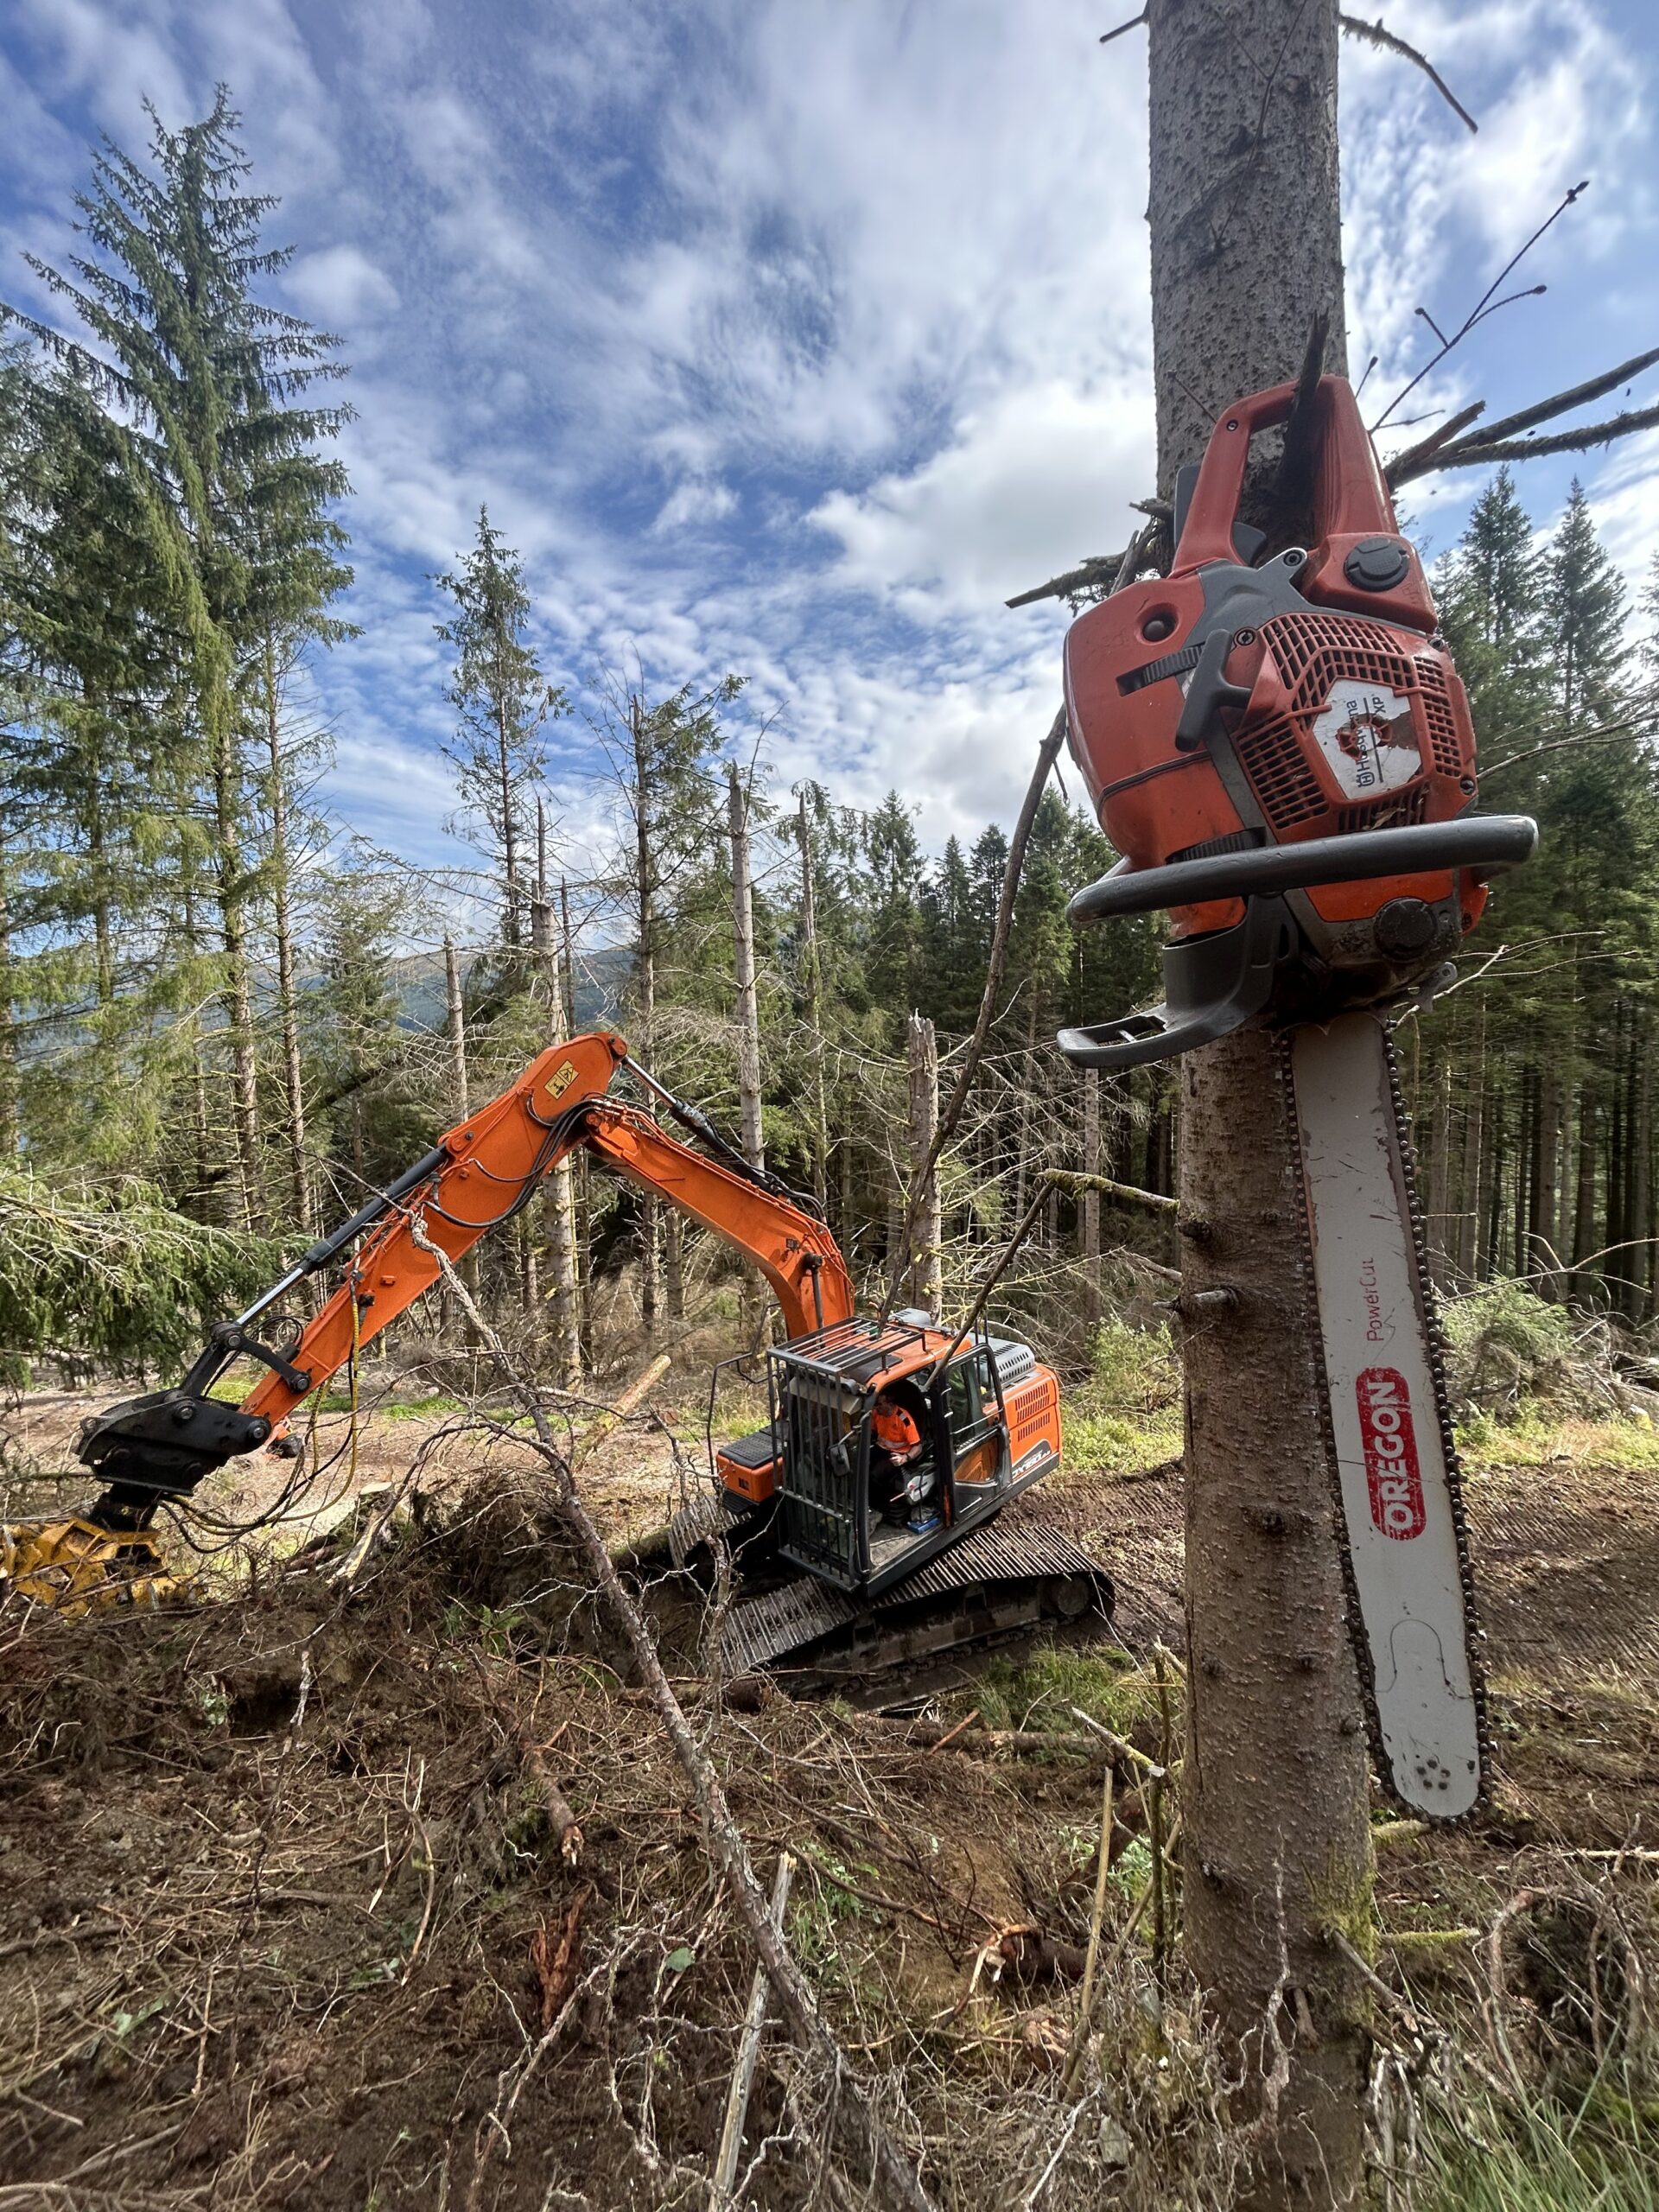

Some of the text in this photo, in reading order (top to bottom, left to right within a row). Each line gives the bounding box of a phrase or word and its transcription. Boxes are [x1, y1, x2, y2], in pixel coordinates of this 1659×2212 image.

[1346, 700, 1370, 772] Hsqvna
[1372, 696, 1386, 716] XP
[1367, 1381, 1414, 1530] OREGON
